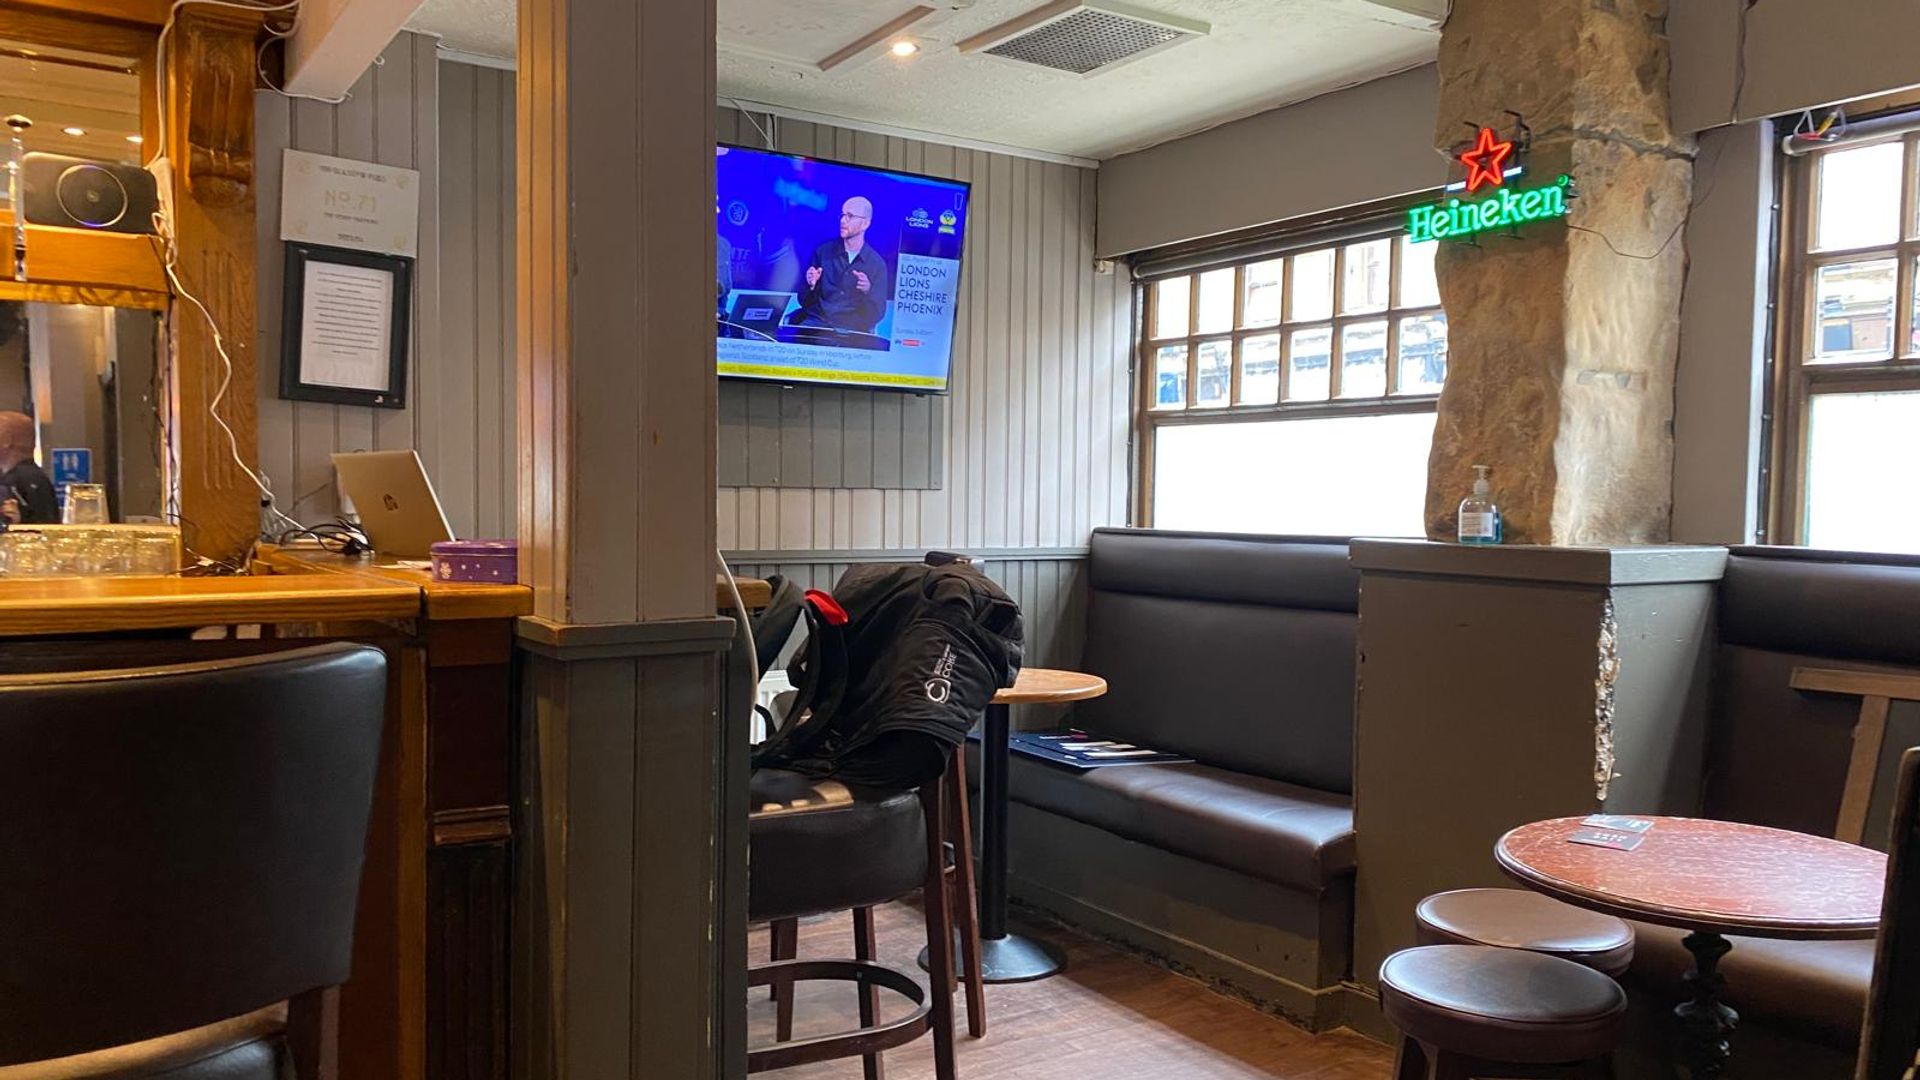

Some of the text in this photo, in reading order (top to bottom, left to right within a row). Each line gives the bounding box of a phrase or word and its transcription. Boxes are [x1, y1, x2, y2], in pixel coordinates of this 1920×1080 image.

[1409, 185, 1566, 244] Heineken
[901, 264, 947, 278] LONDON
[900, 278, 930, 290] LIONS
[898, 289, 948, 304] CHESHIRE
[897, 301, 943, 315] PHOENIX
